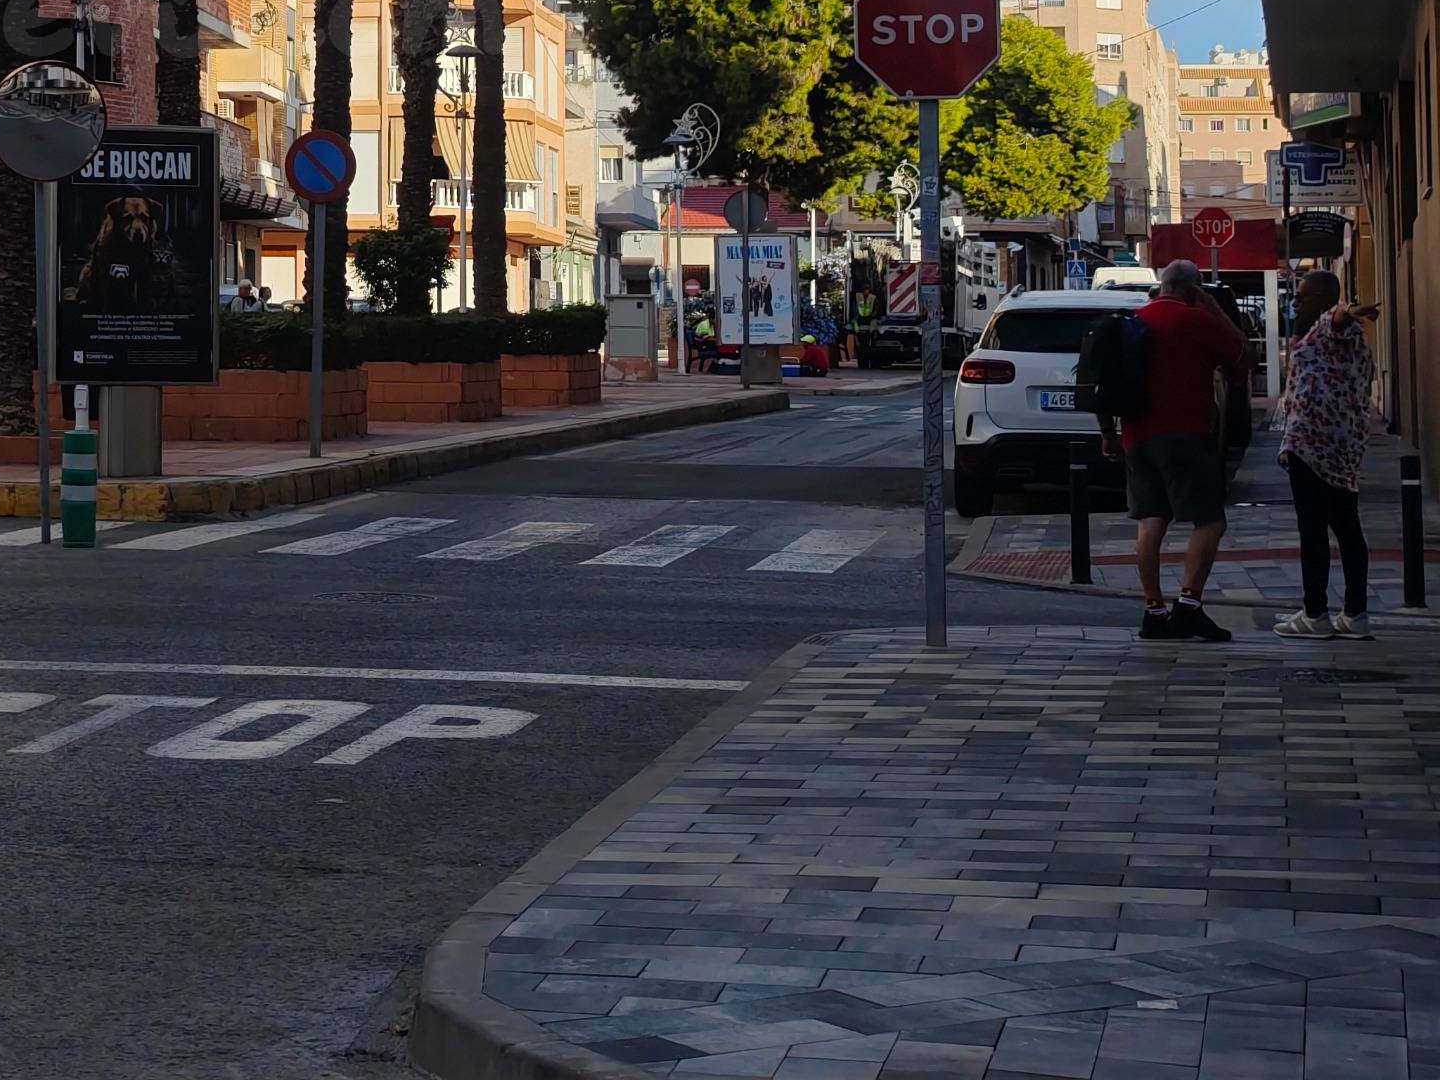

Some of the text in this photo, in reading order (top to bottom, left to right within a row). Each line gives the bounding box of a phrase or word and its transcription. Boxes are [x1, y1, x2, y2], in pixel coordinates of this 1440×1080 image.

[871, 14, 984, 45] STOP
[110, 150, 192, 180] BUSCAN
[1195, 219, 1231, 235] STOP
